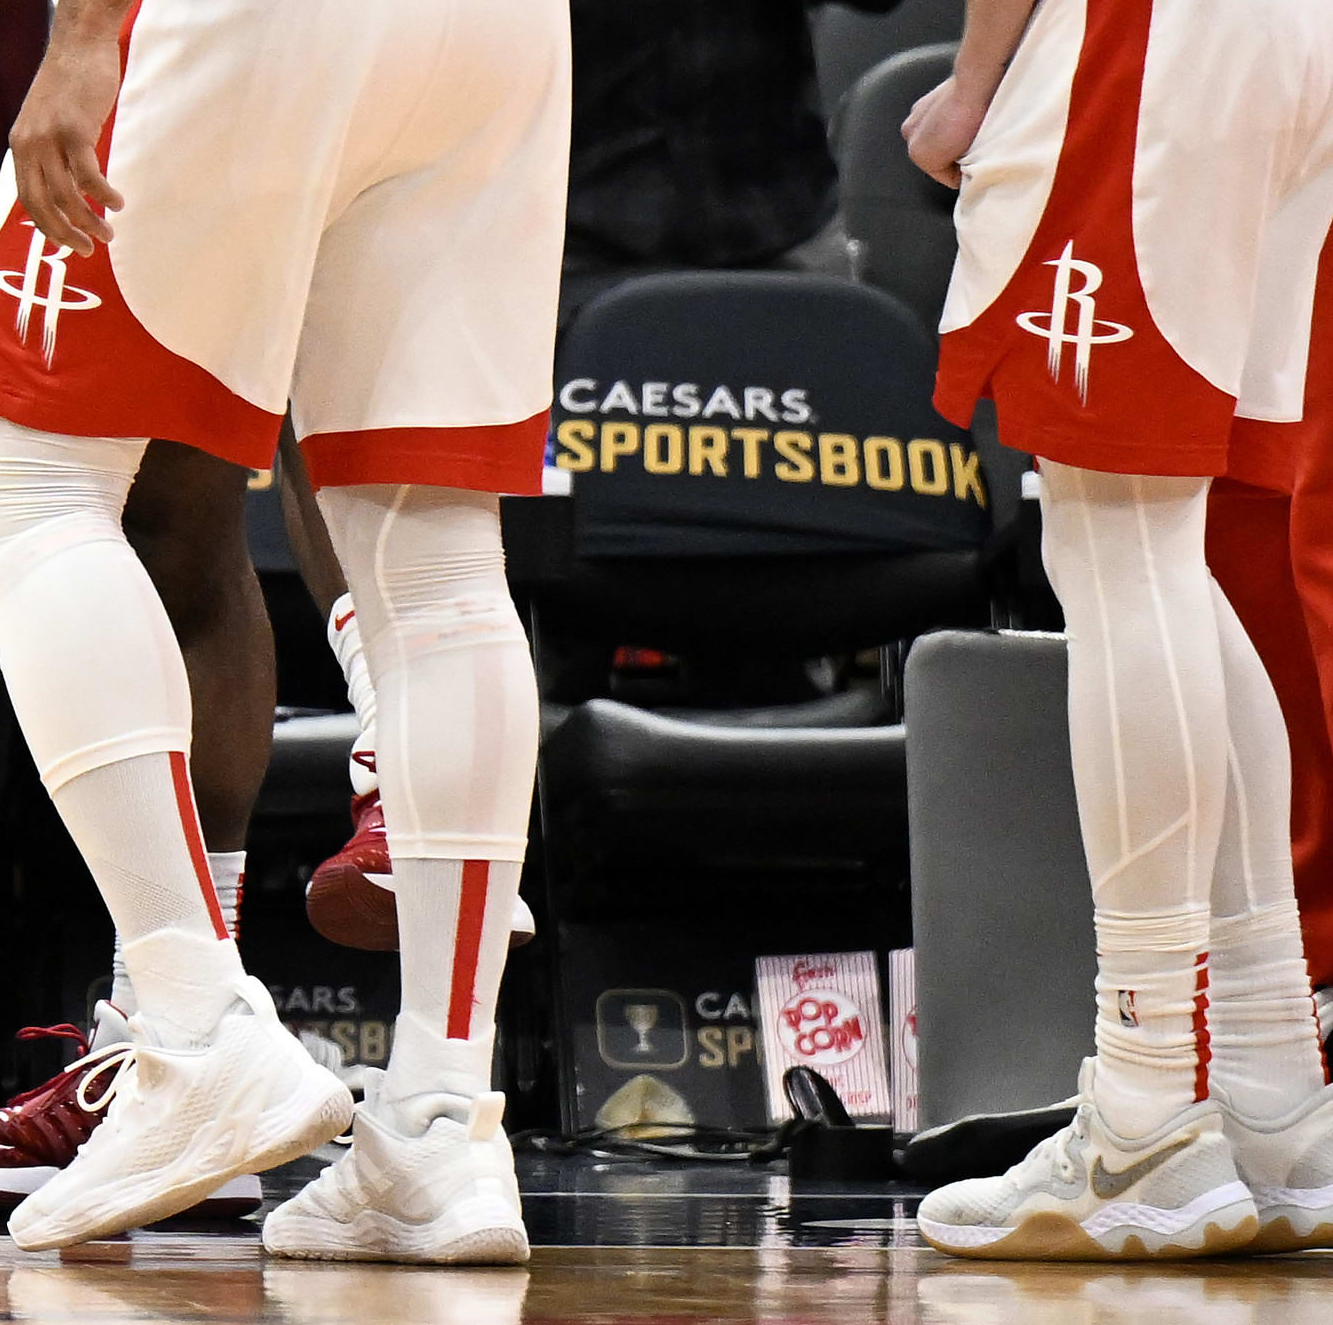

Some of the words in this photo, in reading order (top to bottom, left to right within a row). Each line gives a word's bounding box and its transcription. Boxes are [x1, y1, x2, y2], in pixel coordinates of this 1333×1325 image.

[559, 378, 812, 424] CAESARS
[556, 419, 989, 509] SPORTSBOOK
[695, 992, 753, 1021] CA
[783, 998, 839, 1032] POP
[696, 1026, 758, 1068] SP
